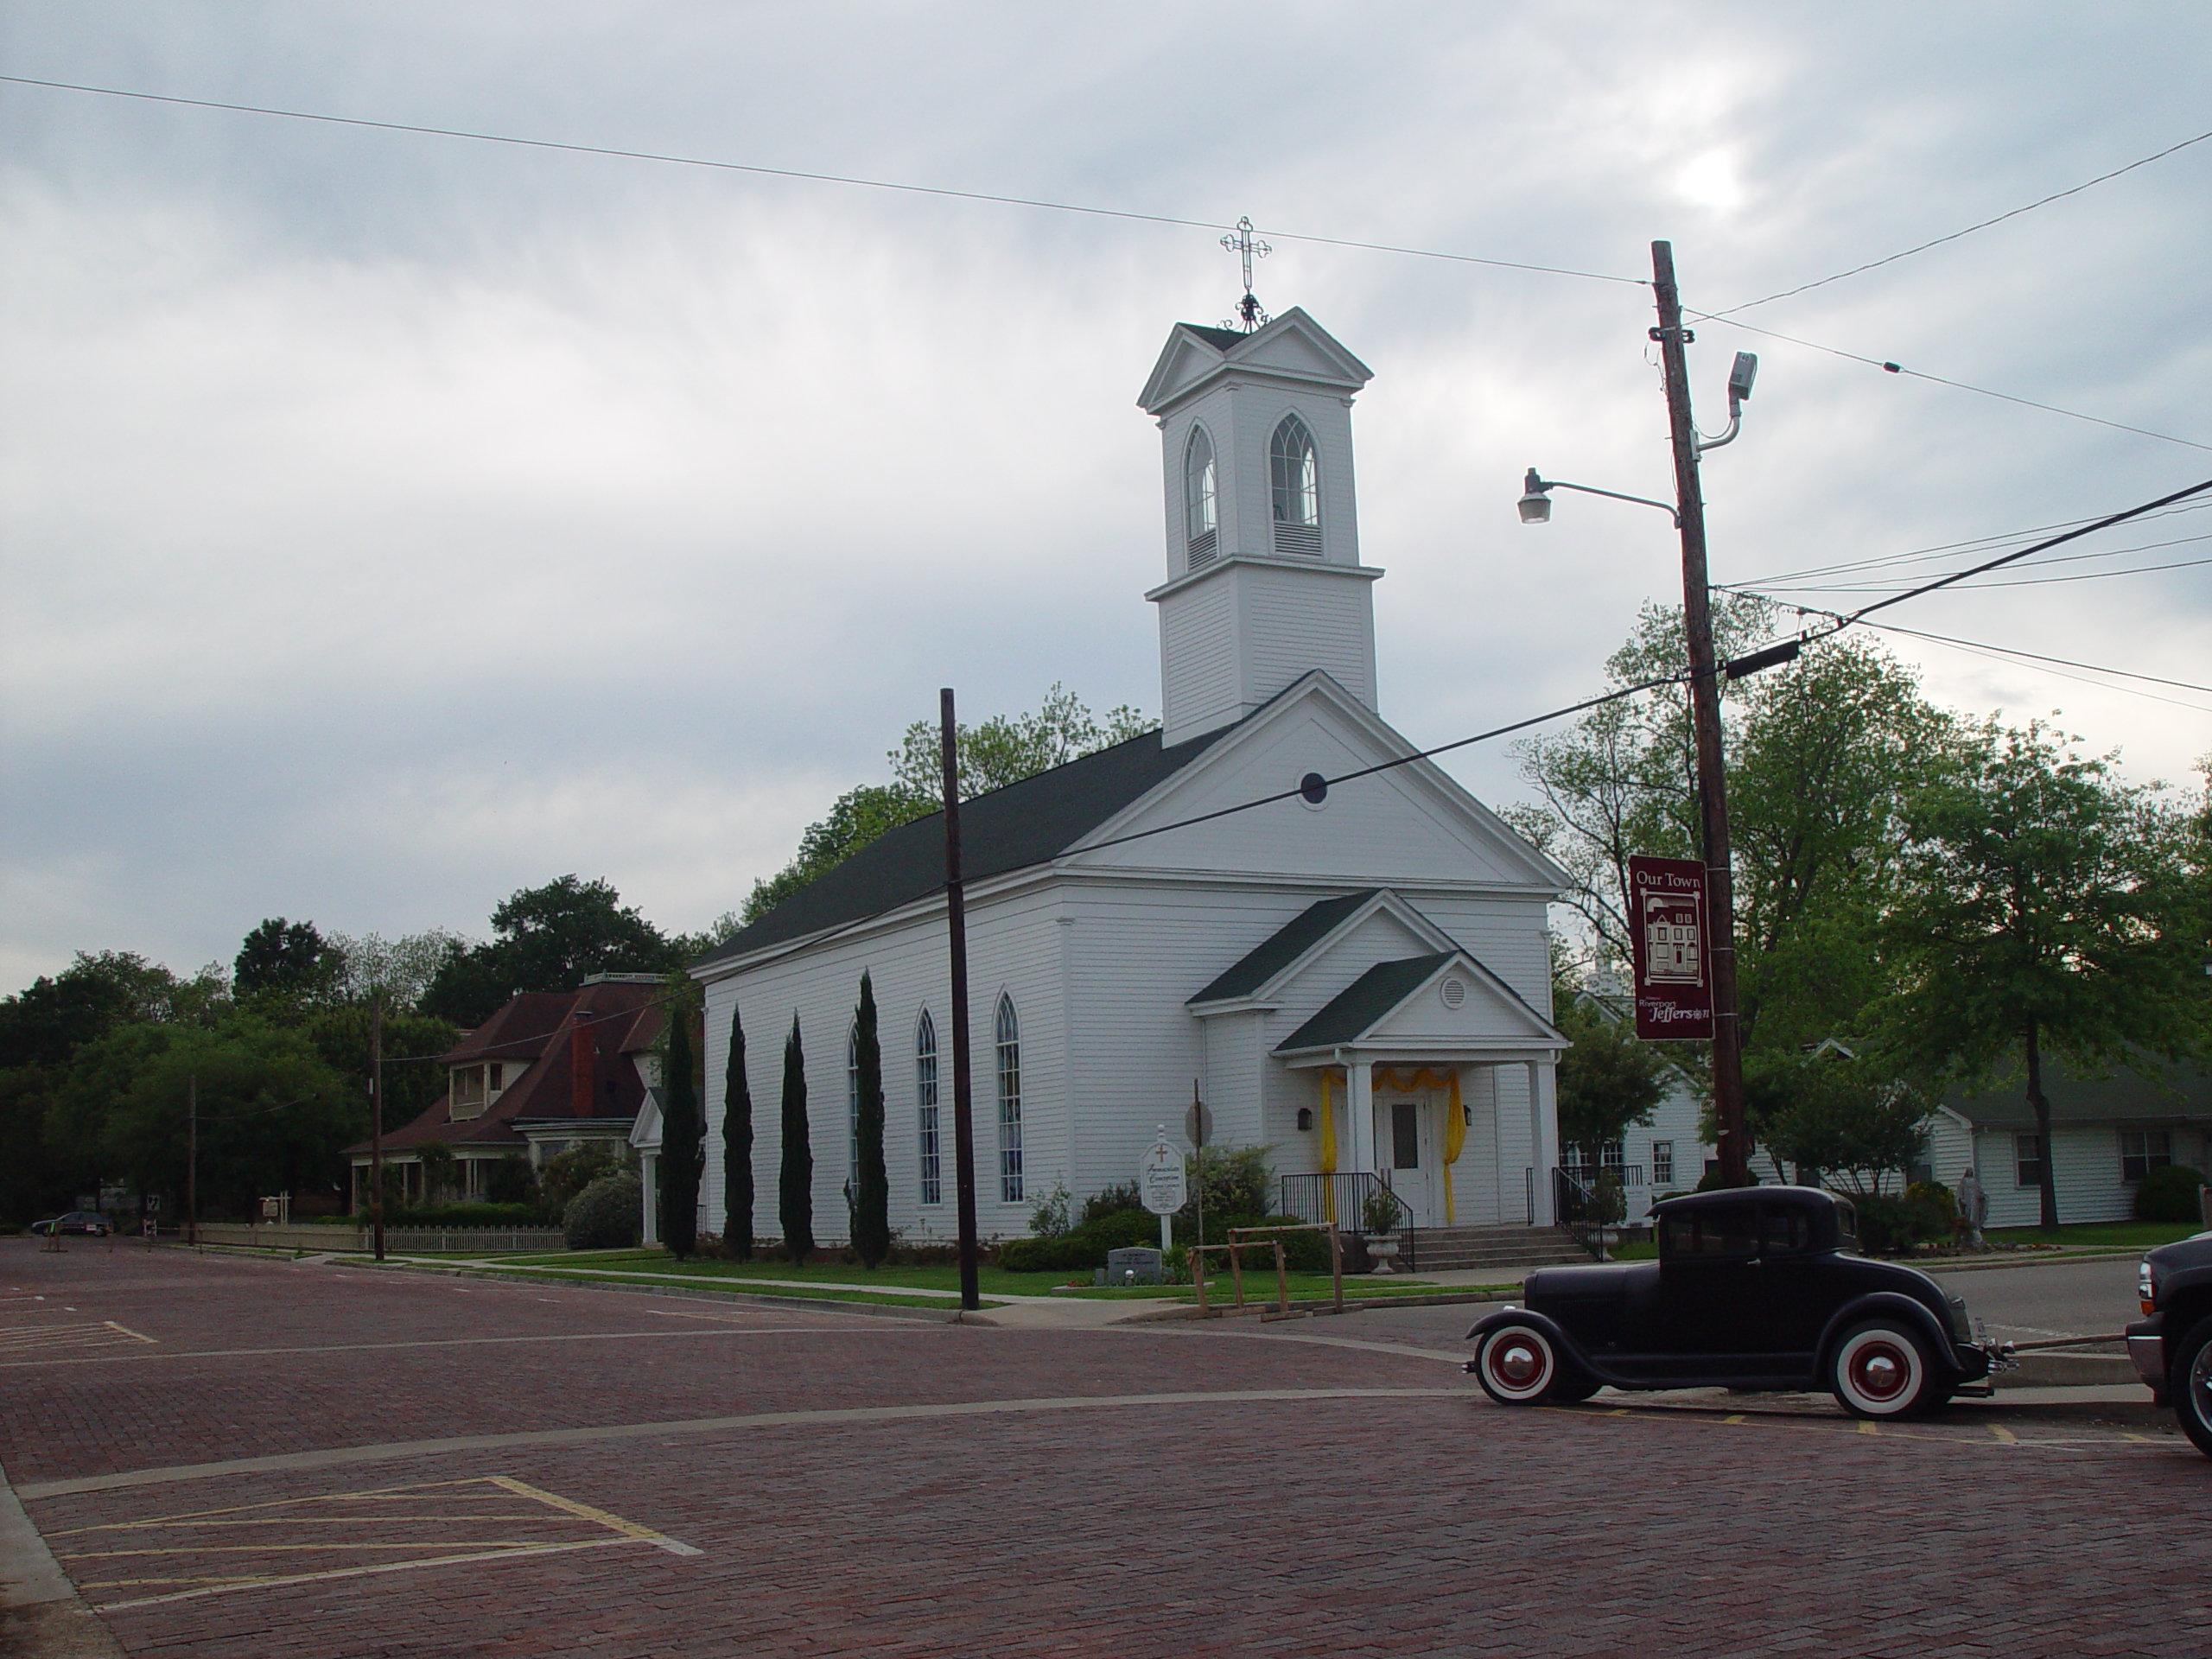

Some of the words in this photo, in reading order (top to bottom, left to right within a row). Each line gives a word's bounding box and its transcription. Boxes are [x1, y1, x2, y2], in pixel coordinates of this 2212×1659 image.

[1636, 870, 1662, 886] Our
[1664, 872, 1701, 888] Town
[1649, 1007, 1710, 1023] Jefferson
